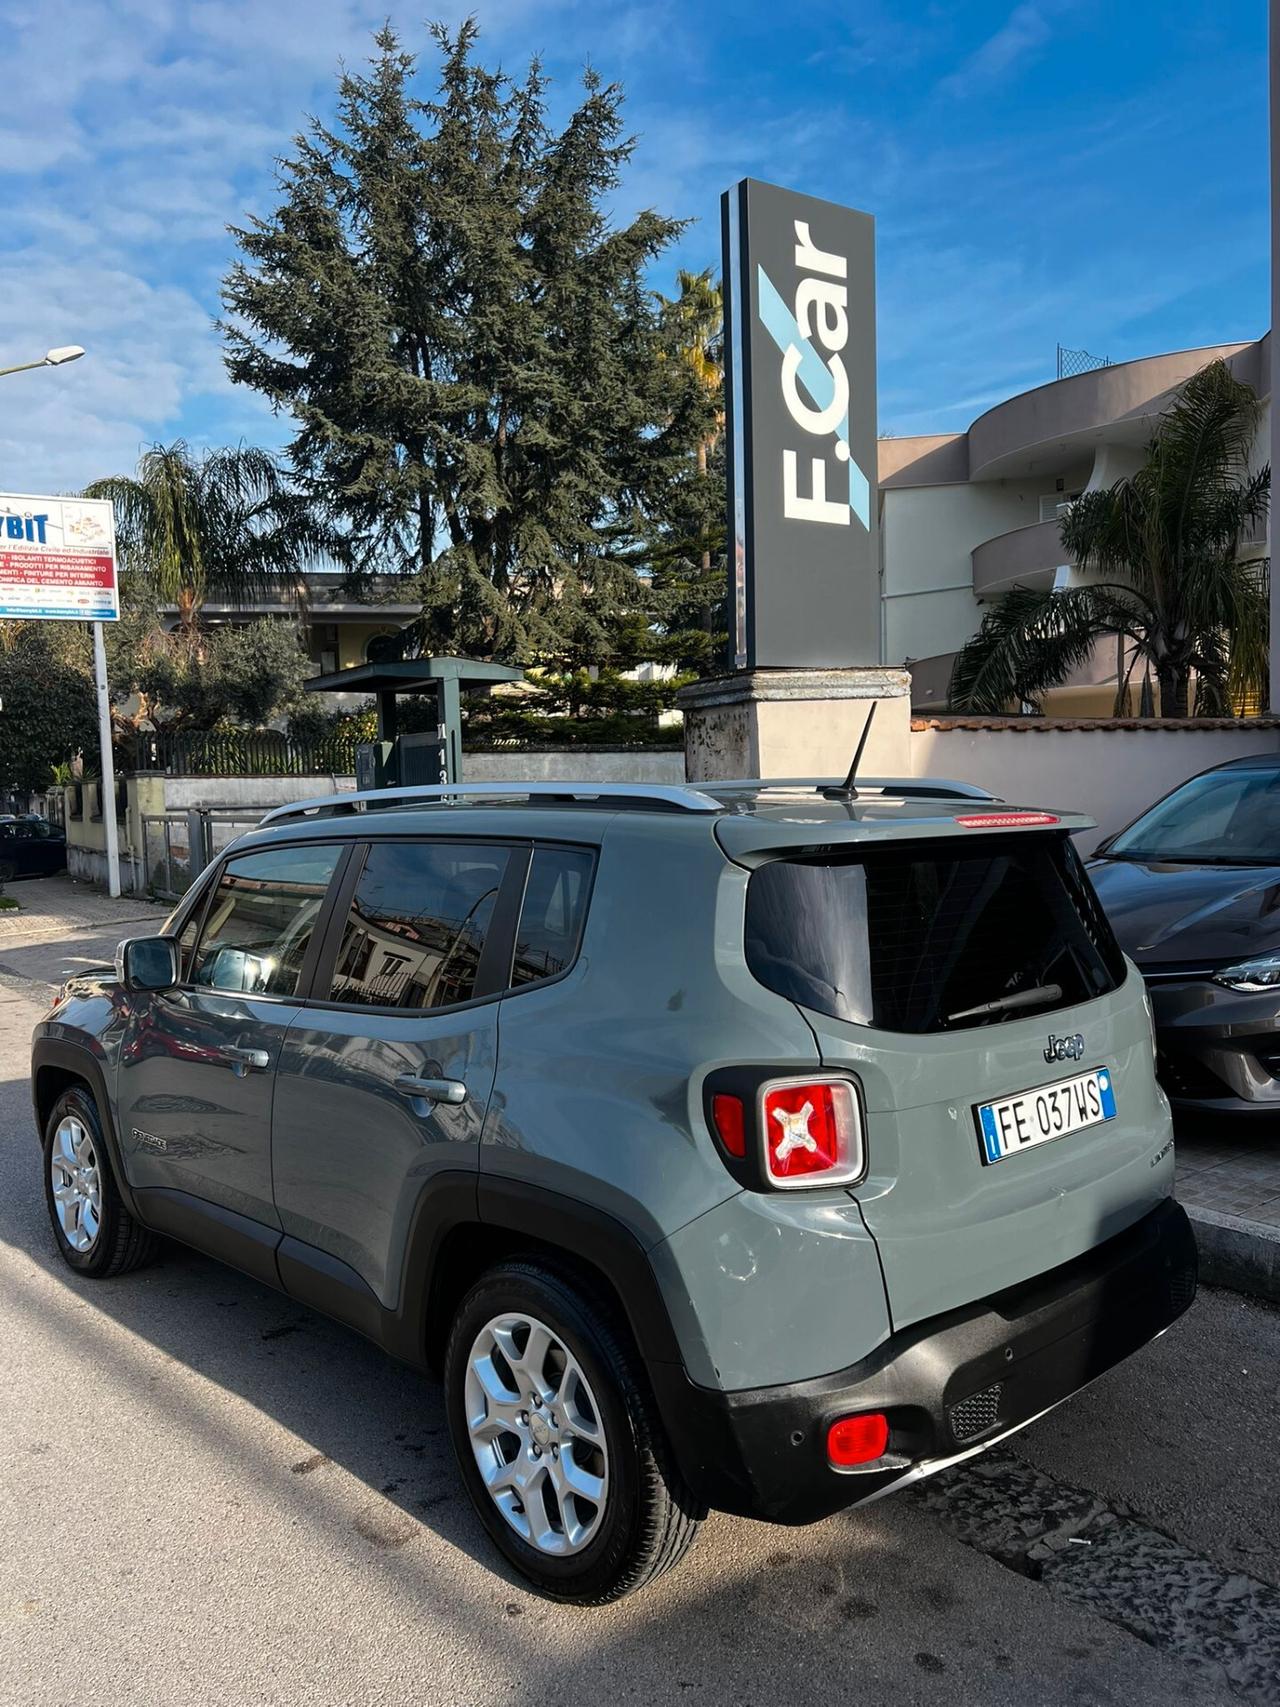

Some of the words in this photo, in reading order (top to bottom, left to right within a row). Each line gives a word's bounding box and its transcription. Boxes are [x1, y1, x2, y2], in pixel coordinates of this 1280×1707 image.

[781, 219, 850, 526] F.Car
[11, 555, 43, 563] ISOLANTI
[44, 557, 97, 565] TERMOACUSTICI
[10, 562, 44, 570] PRODOTTI
[60, 565, 107, 573] RISANAMENTO
[24, 570, 54, 578] FINITURE
[70, 572, 96, 580] INTERNI
[40, 578, 73, 587] CEMENTO
[1043, 1033, 1085, 1064] Jeep
[998, 1101, 1032, 1150] FE
[1035, 1079, 1101, 1136] 037WS
